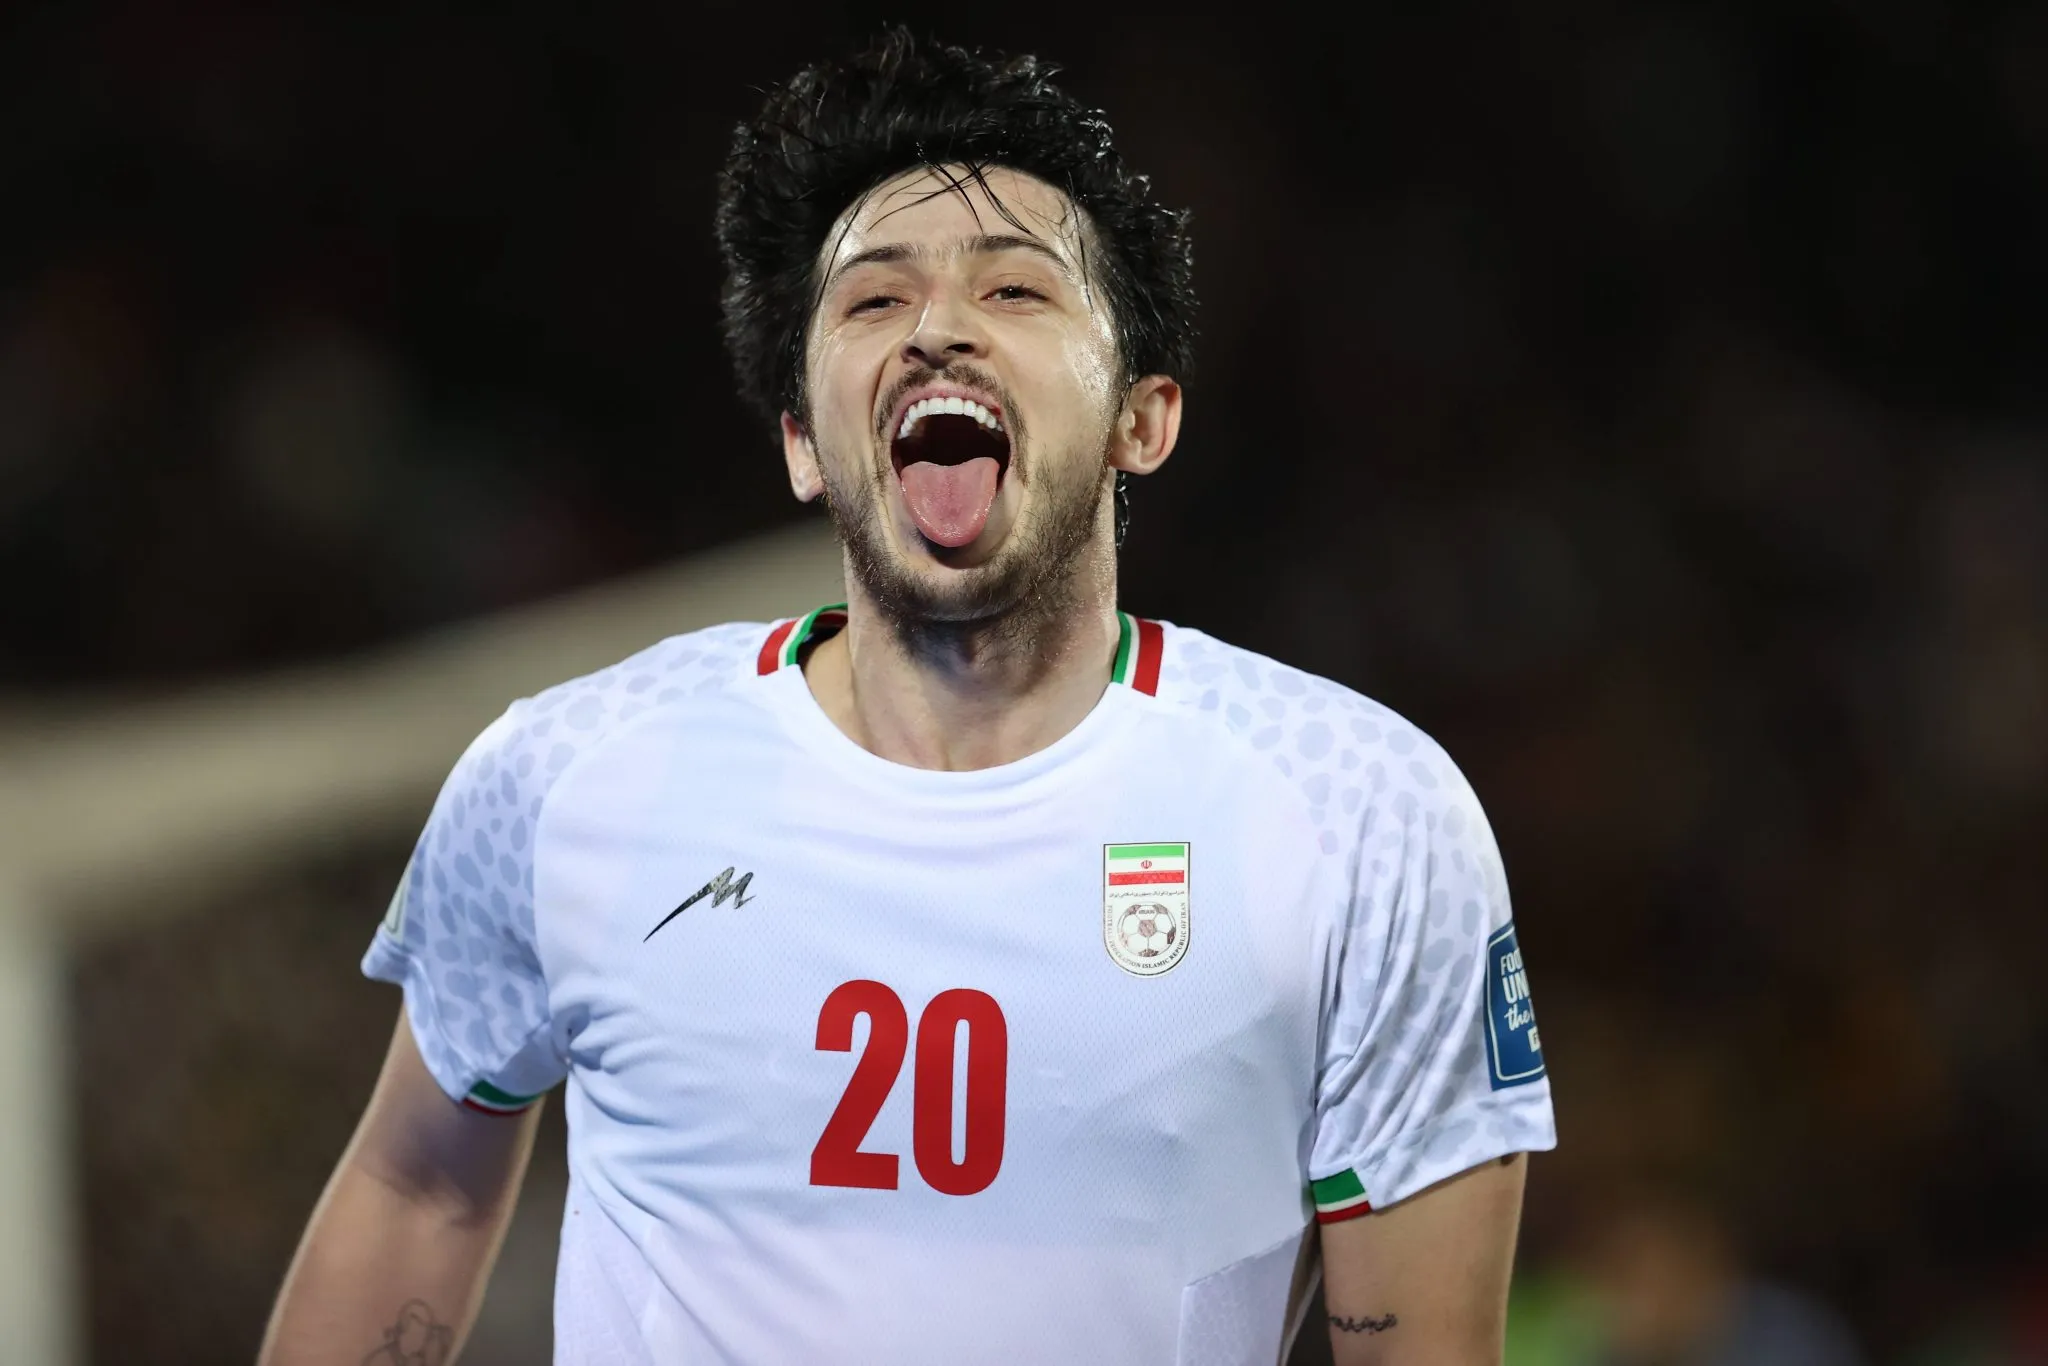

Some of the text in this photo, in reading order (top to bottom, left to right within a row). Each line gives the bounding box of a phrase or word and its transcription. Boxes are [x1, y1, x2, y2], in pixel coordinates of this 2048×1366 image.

[1142, 958, 1170, 969] ISLAMIC
[1504, 1004, 1530, 1031] the
[809, 979, 1008, 1196] 20
